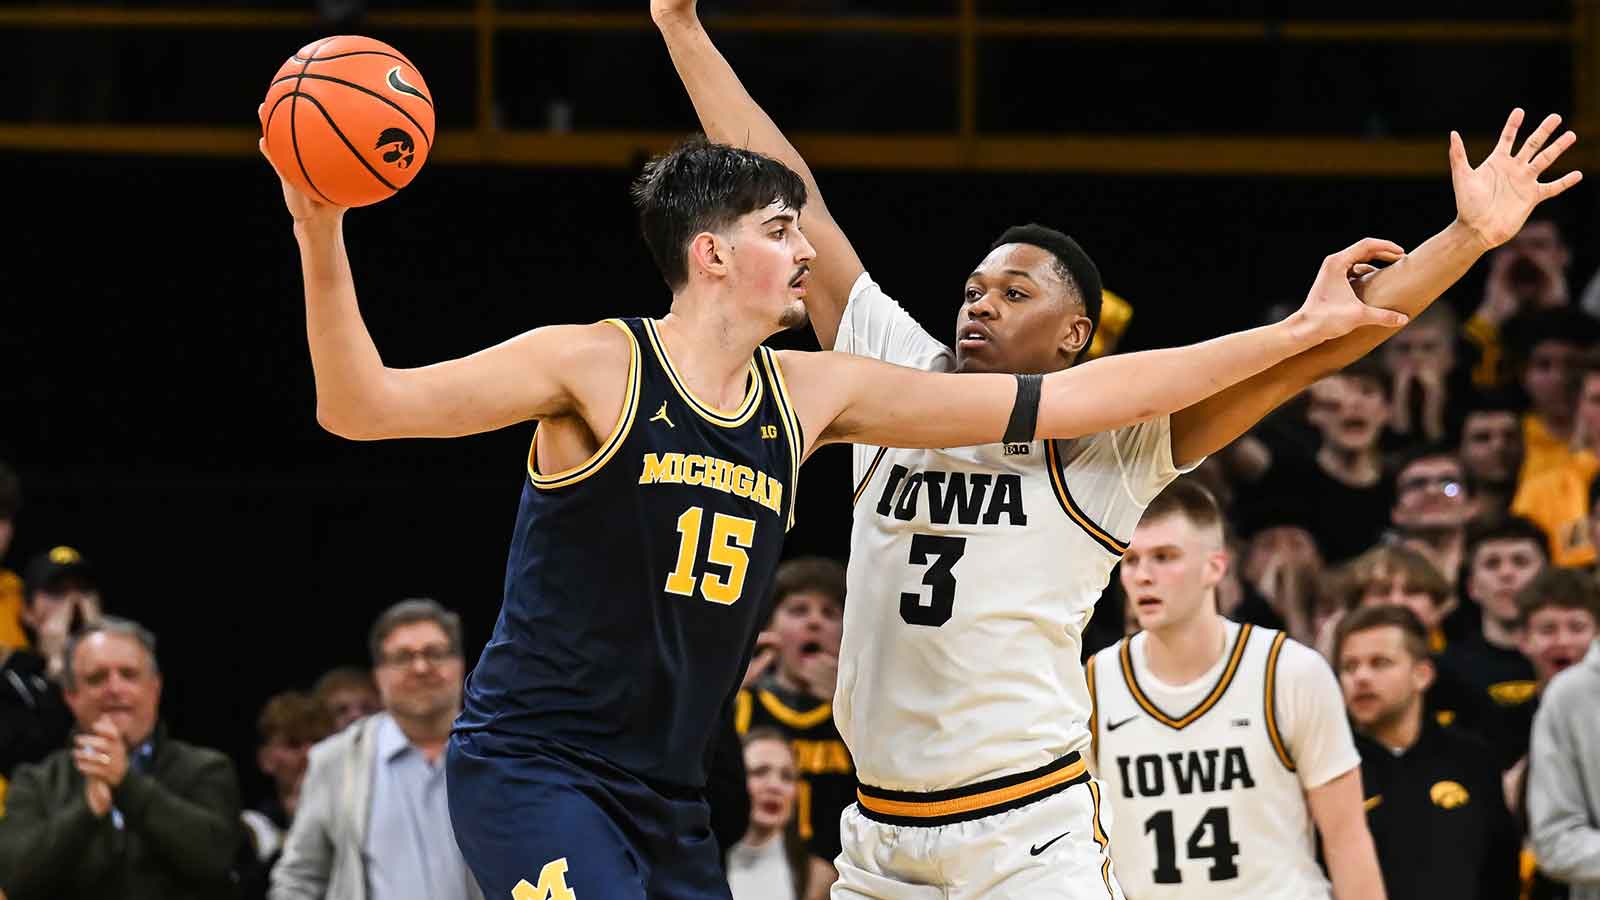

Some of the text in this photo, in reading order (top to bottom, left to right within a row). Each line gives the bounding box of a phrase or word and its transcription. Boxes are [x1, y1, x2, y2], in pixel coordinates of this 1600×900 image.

[639, 452, 783, 517] MICHIGAN
[876, 464, 1028, 526] IOWA
[664, 506, 757, 606] 15
[899, 533, 967, 628] 3
[1116, 746, 1256, 799] IOWA
[1144, 806, 1240, 885] 14
